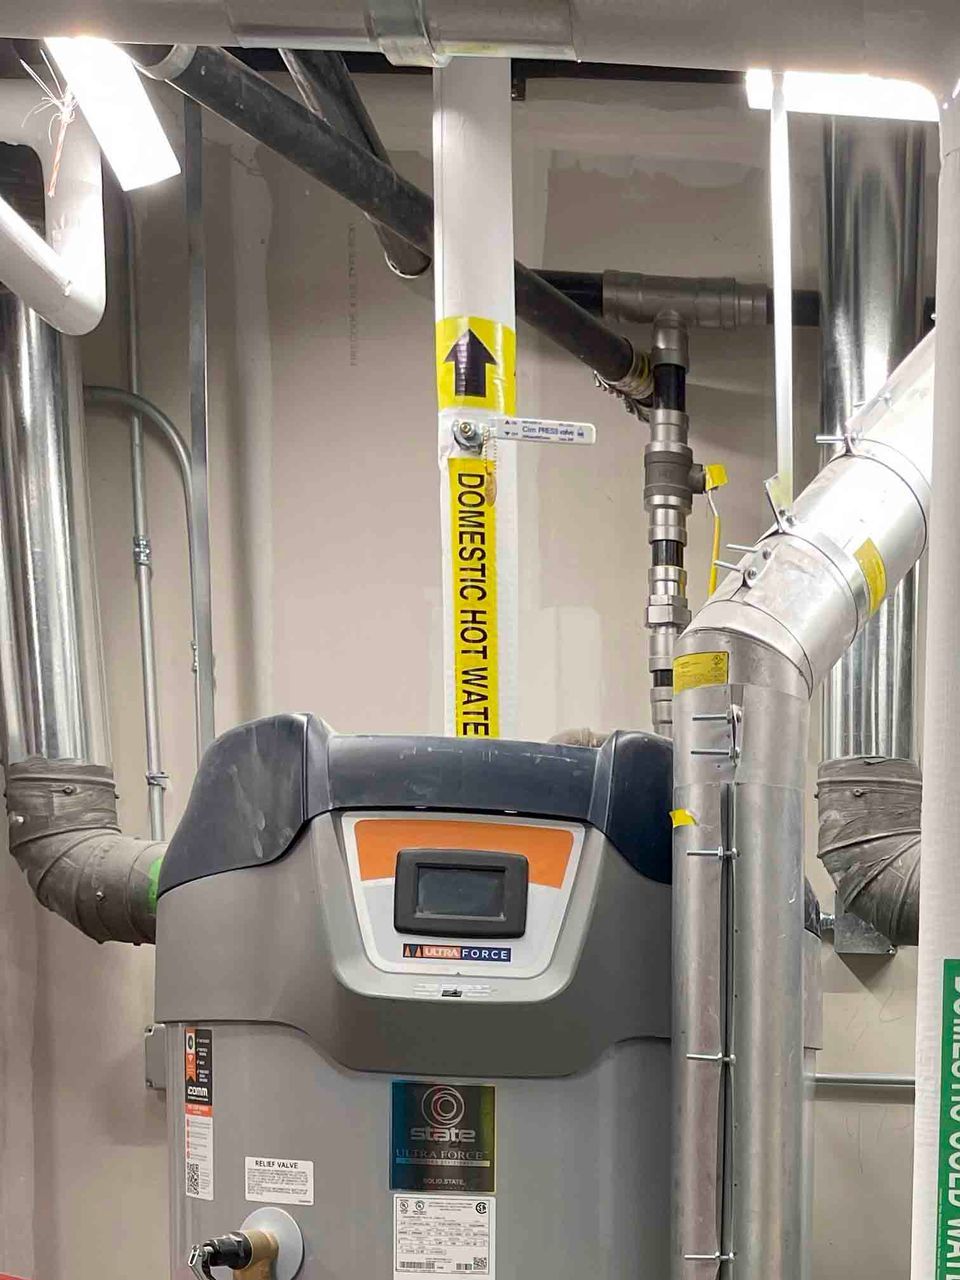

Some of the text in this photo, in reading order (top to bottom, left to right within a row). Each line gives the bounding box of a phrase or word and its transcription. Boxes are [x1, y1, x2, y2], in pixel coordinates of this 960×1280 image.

[457, 473, 489, 736] DOMESTIC HOT WATE
[423, 947, 508, 960] ULTRA FORCE
[410, 1127, 476, 1143] state
[441, 1150, 483, 1159] FORCE
[255, 1160, 298, 1169] RELIEF VALVE
